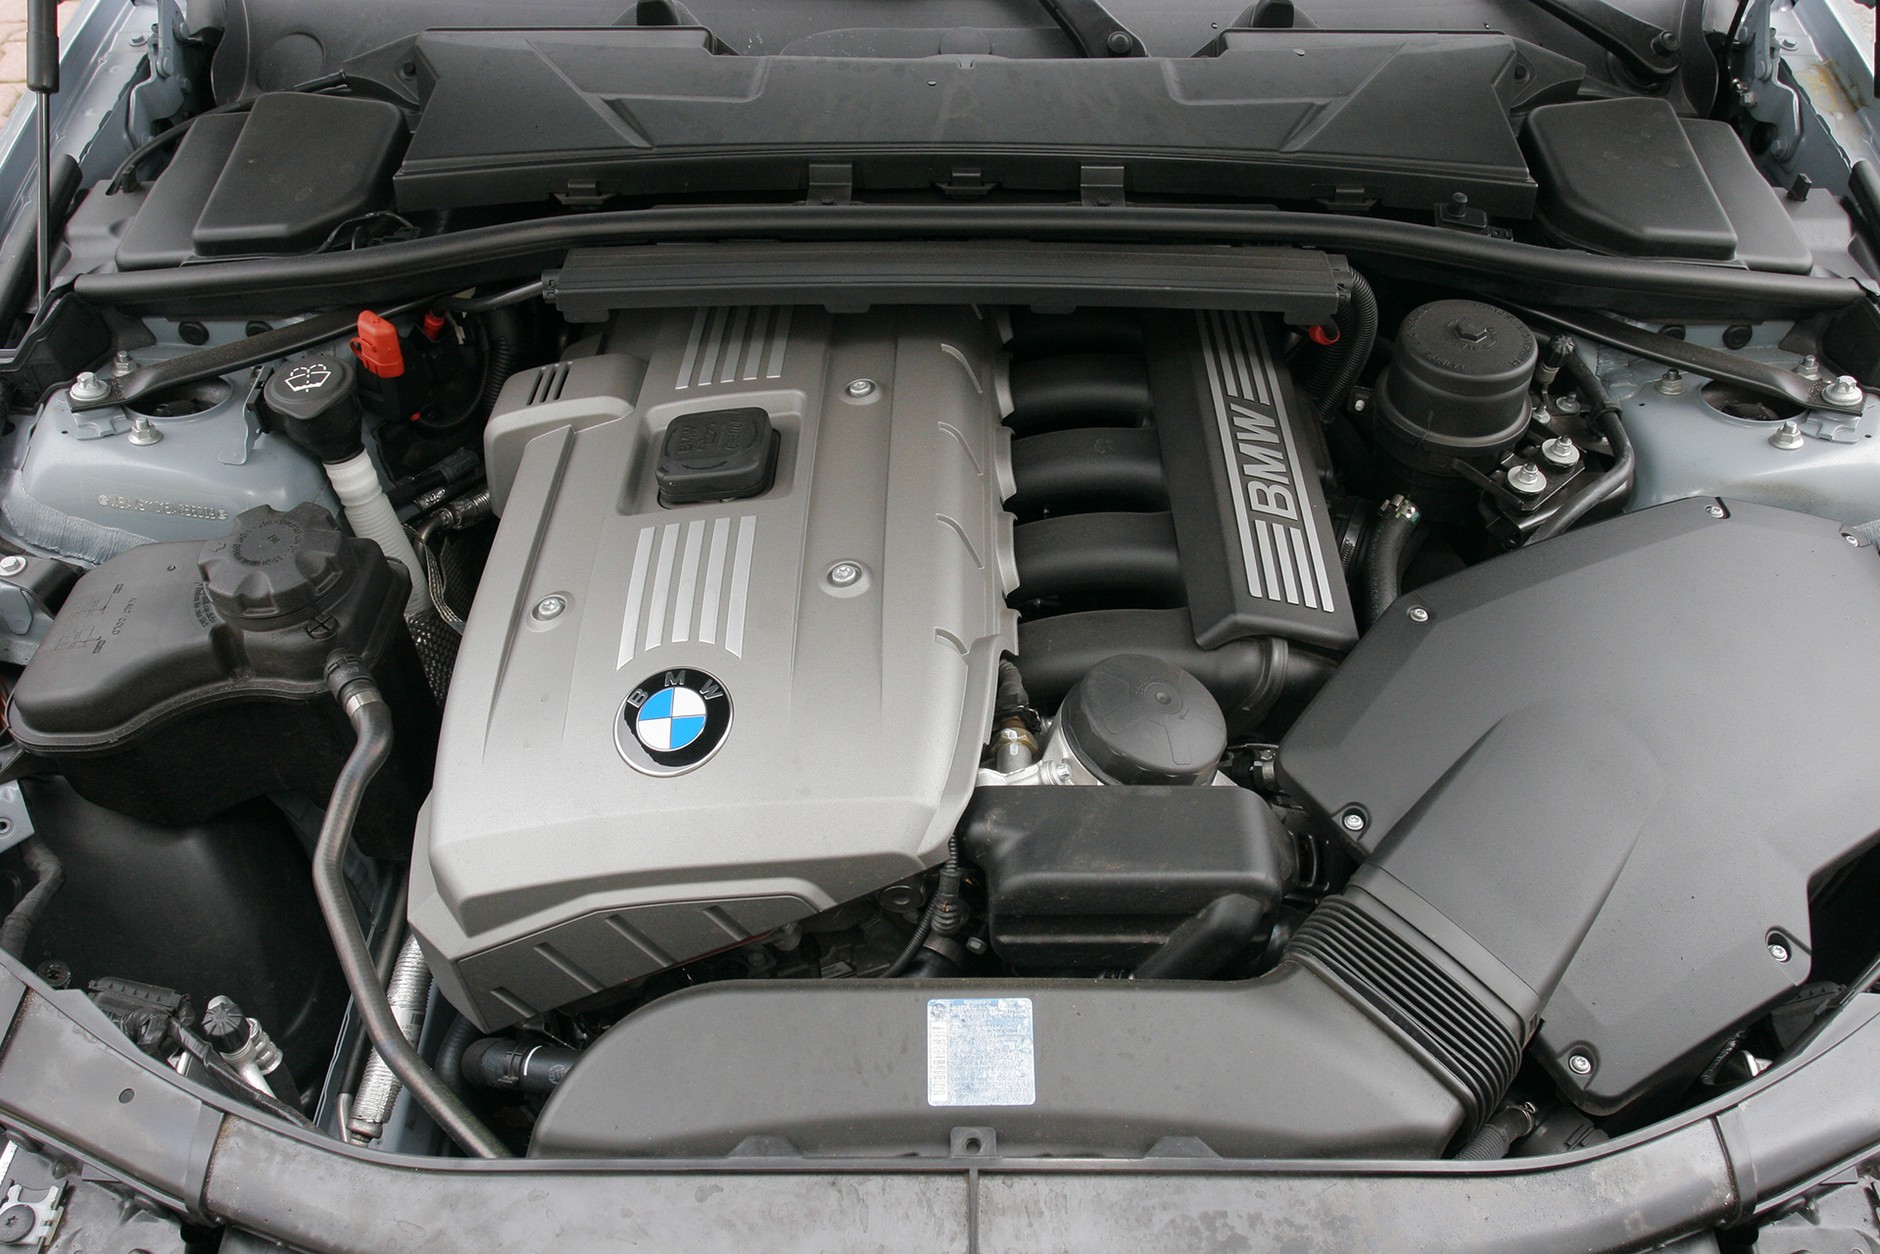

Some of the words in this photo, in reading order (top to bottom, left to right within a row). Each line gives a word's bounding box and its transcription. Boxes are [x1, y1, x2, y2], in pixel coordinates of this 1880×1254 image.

[679, 426, 697, 454] BMW
[1230, 403, 1298, 520] BMW
[626, 669, 723, 709] BMW
